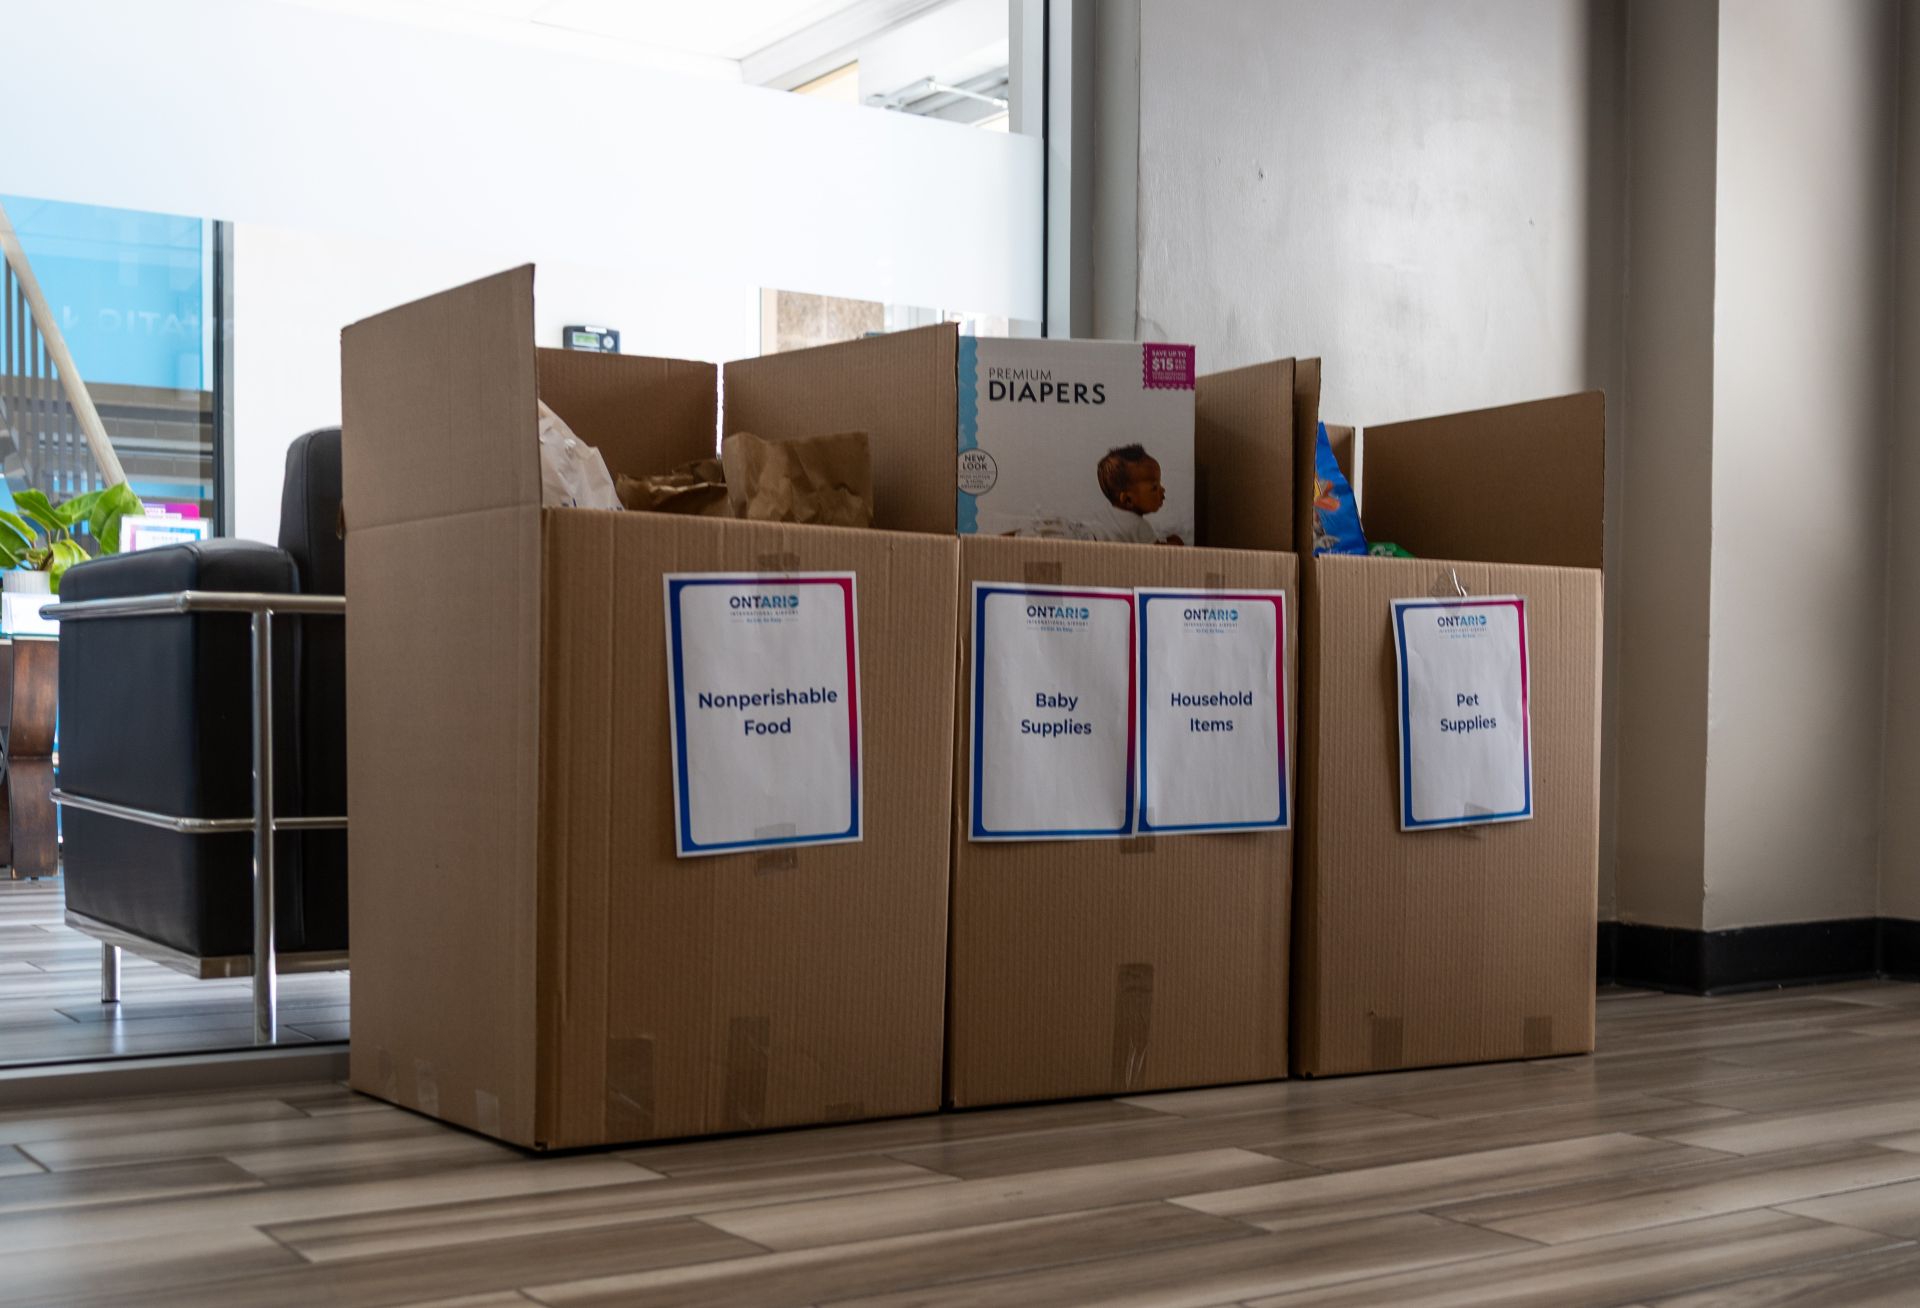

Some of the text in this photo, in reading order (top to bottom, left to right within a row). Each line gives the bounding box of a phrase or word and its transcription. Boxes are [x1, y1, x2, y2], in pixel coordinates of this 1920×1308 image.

[1151, 357, 1174, 370] $15
[988, 367, 1052, 380] PREMIUM
[988, 380, 1106, 405] DIAPERS
[964, 454, 986, 462] NEW
[962, 462, 988, 470] LOOK
[729, 595, 799, 609] ONTARIO
[1026, 605, 1089, 620] ONTARIO
[1183, 608, 1239, 621] ONTARIO
[1437, 615, 1487, 627] ONTARIO
[698, 687, 838, 711] Nonperishable
[1035, 692, 1078, 712] Baby
[1170, 691, 1253, 707] Household
[1456, 692, 1479, 707] Pet
[744, 717, 792, 736] Food
[1020, 718, 1092, 738] Supplies
[1190, 717, 1234, 732] Items
[1440, 714, 1497, 735] Supplies
